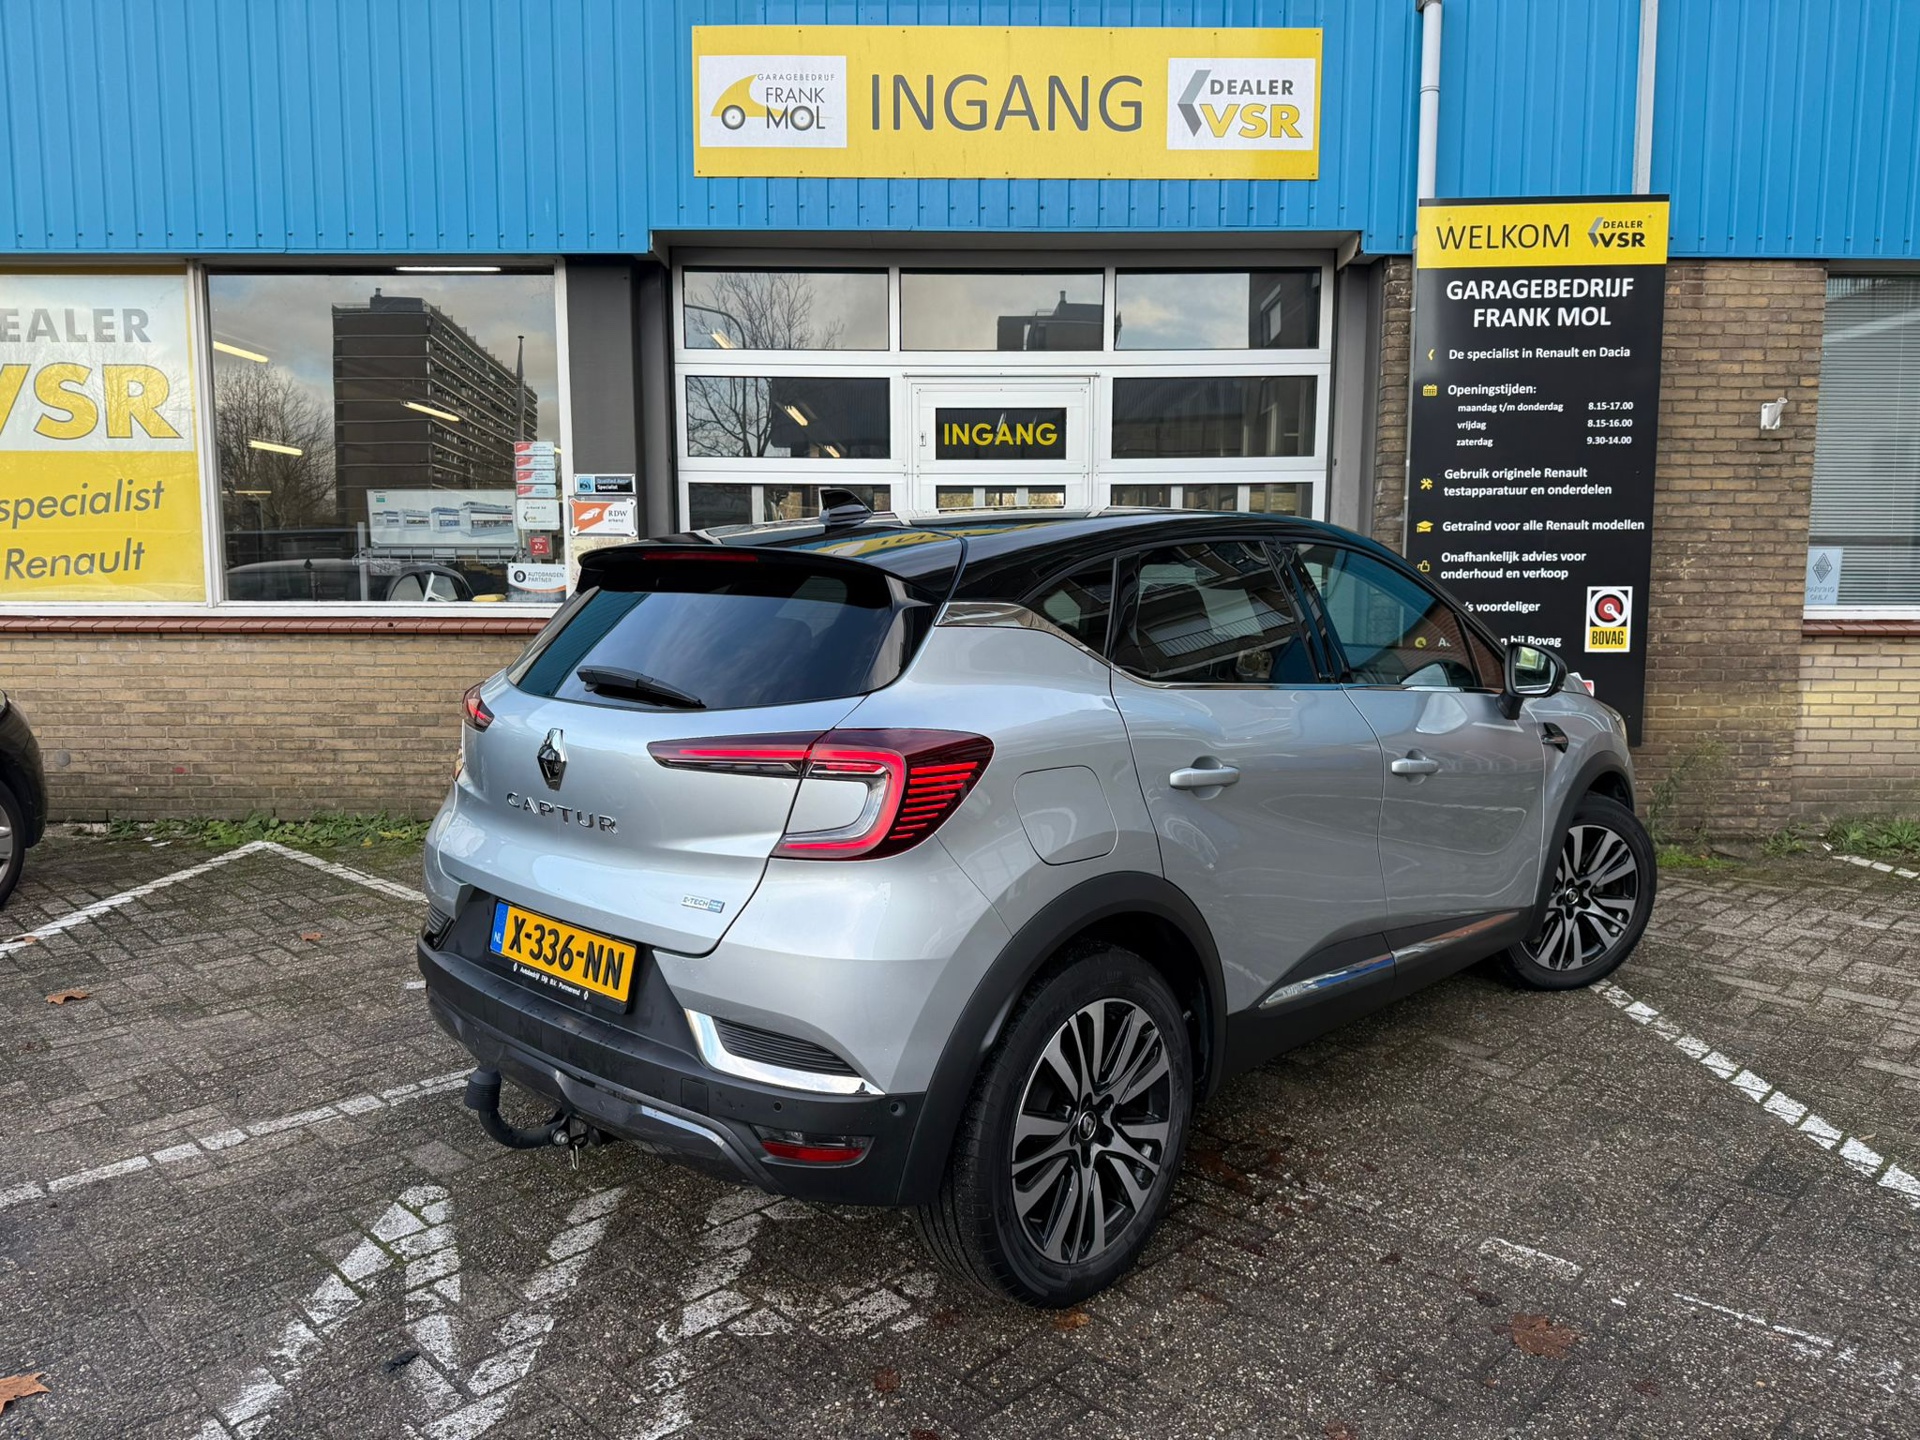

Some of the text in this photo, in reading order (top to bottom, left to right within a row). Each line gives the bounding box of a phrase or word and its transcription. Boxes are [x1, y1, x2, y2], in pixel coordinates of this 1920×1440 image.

[1210, 79, 1293, 96] DEALER
[766, 87, 825, 103] FRANK
[871, 73, 1143, 133] INGANG
[766, 105, 826, 131] MOL
[1199, 103, 1303, 139] VSR
[1602, 220, 1643, 229] DEALER
[1436, 224, 1570, 250] WELKOM
[1599, 232, 1645, 248] VSR
[1446, 278, 1634, 300] GARAGEBEDRIJF
[1473, 307, 1611, 327] FRANK MOL
[1449, 347, 1630, 361] De specialist in Renault en Dacia
[1448, 384, 1537, 397] Openingstijden:
[1458, 402, 1563, 413] maandag t/m donderdag
[1588, 402, 1633, 410] 8.15-17.00
[1457, 420, 1487, 430] vrijdag
[1588, 419, 1632, 428] 8.15-16.00
[944, 423, 1058, 446] INGANG
[1587, 436, 1631, 445] 9.30-14.00
[1457, 437, 1493, 447] zaterdag
[1444, 468, 1587, 480] Gebruik originele Renault
[1444, 484, 1612, 497] testapparatuur en onderdelen
[0, 479, 165, 530] specialist
[1442, 520, 1644, 532] Getraind voor alle Renault modellen
[4, 537, 145, 580] Renault
[1441, 551, 1586, 563] Onafhankelijk advies voor
[1441, 568, 1568, 580] onderhoud en verkoop
[1476, 601, 1541, 614] voordeliger
[1528, 636, 1562, 648] Bovag
[1592, 630, 1624, 645] BOVAG
[506, 792, 619, 835] CAPTUR
[683, 896, 709, 907] E-TECH
[494, 932, 502, 944] NL
[508, 915, 625, 990] X-336-NN
